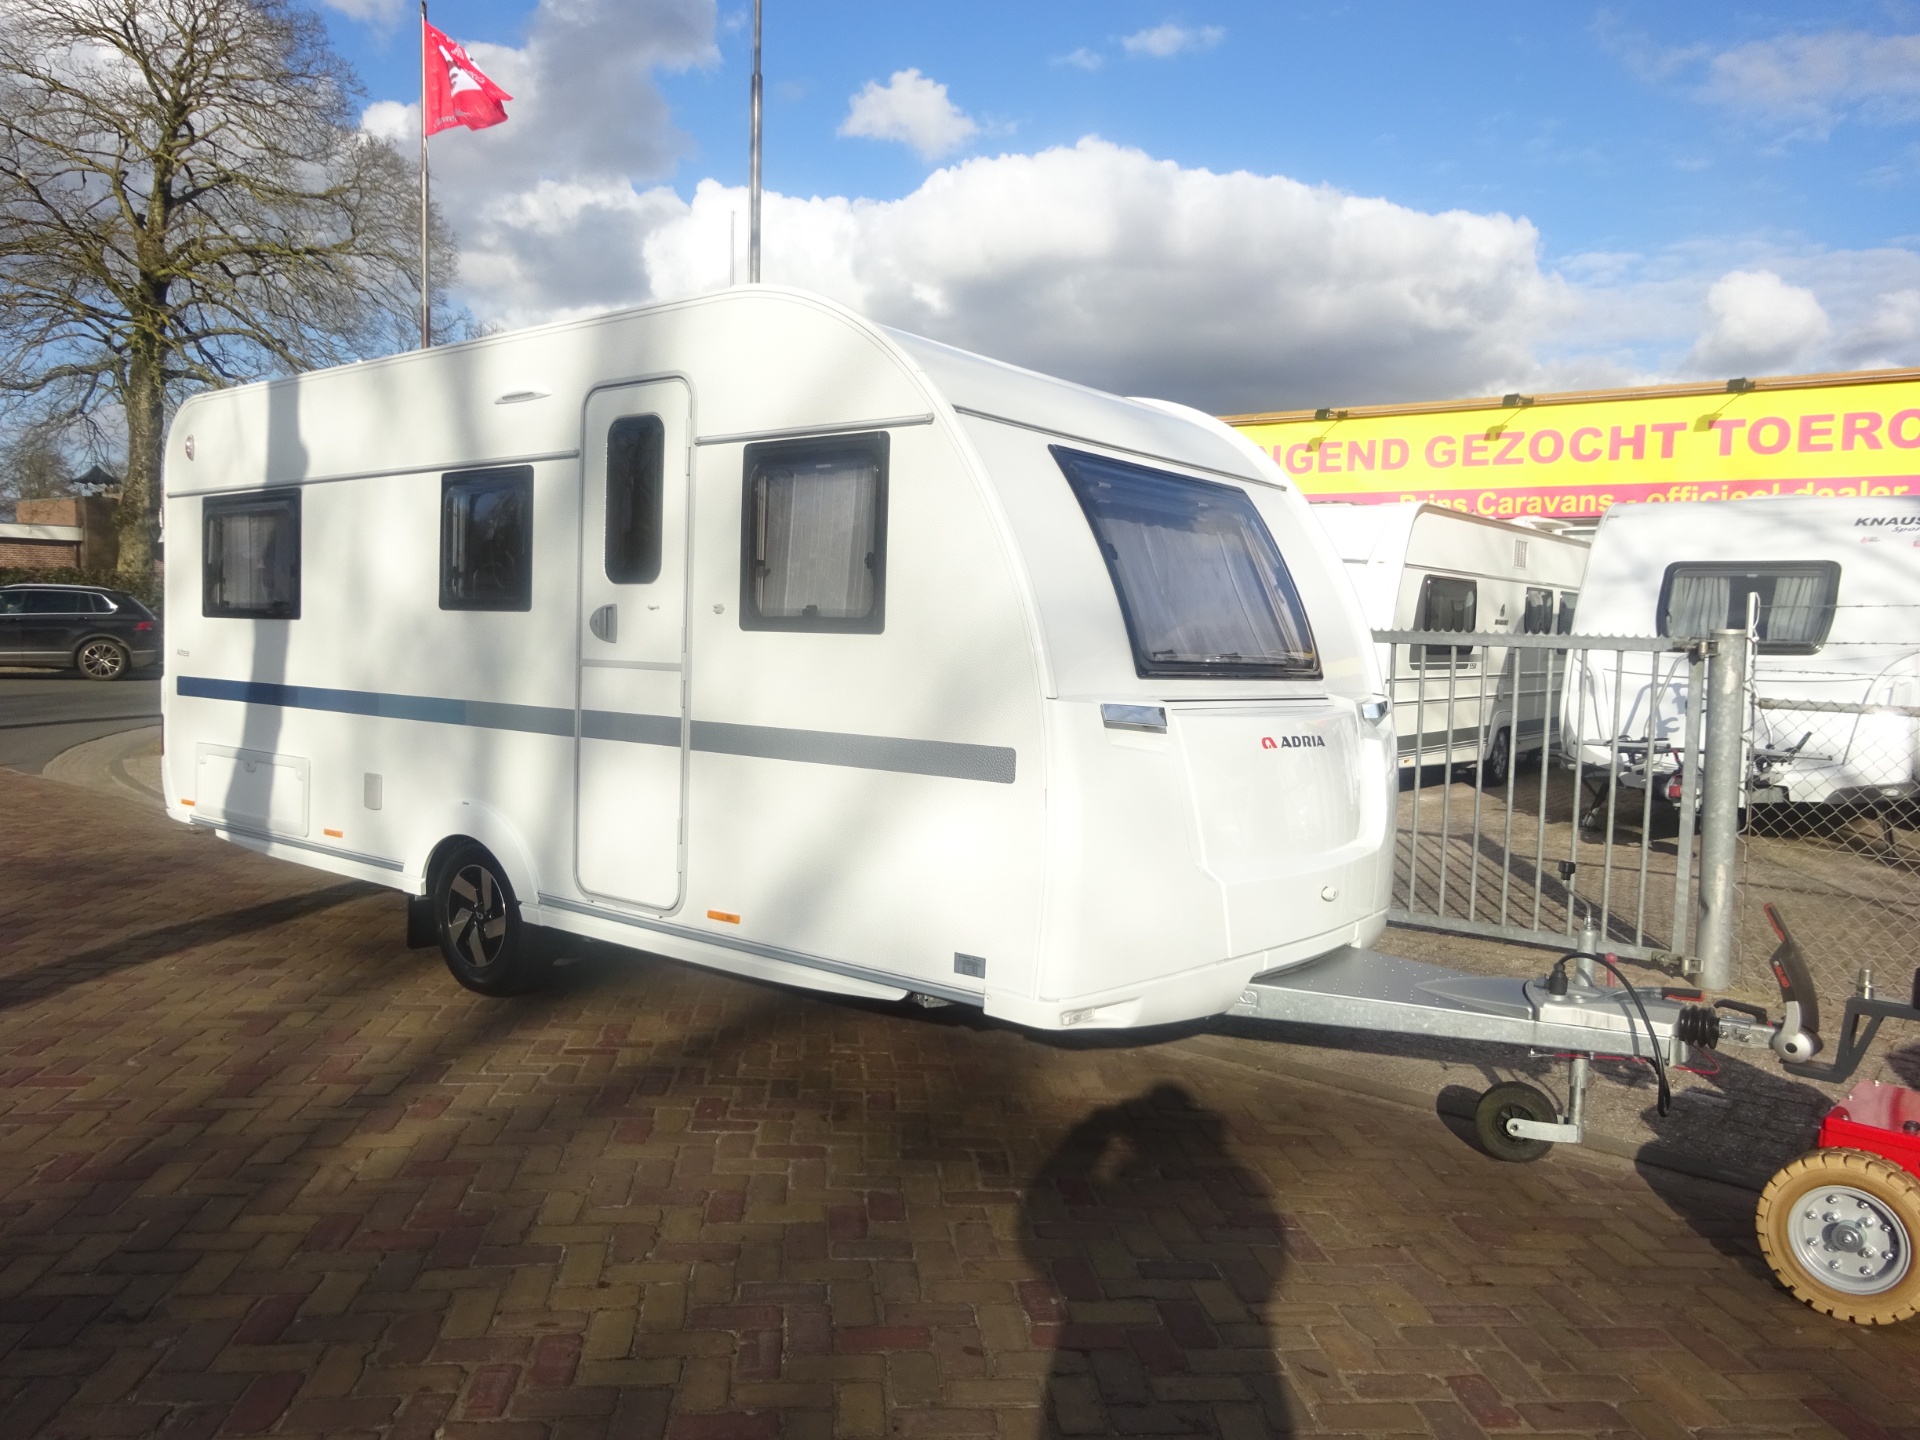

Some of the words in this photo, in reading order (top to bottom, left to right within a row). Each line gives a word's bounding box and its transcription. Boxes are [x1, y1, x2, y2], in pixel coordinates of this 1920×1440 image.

[1425, 422, 1688, 469] GEZOCHT
[1477, 491, 1614, 515] Caravans
[1281, 735, 1326, 748] ADRIA
